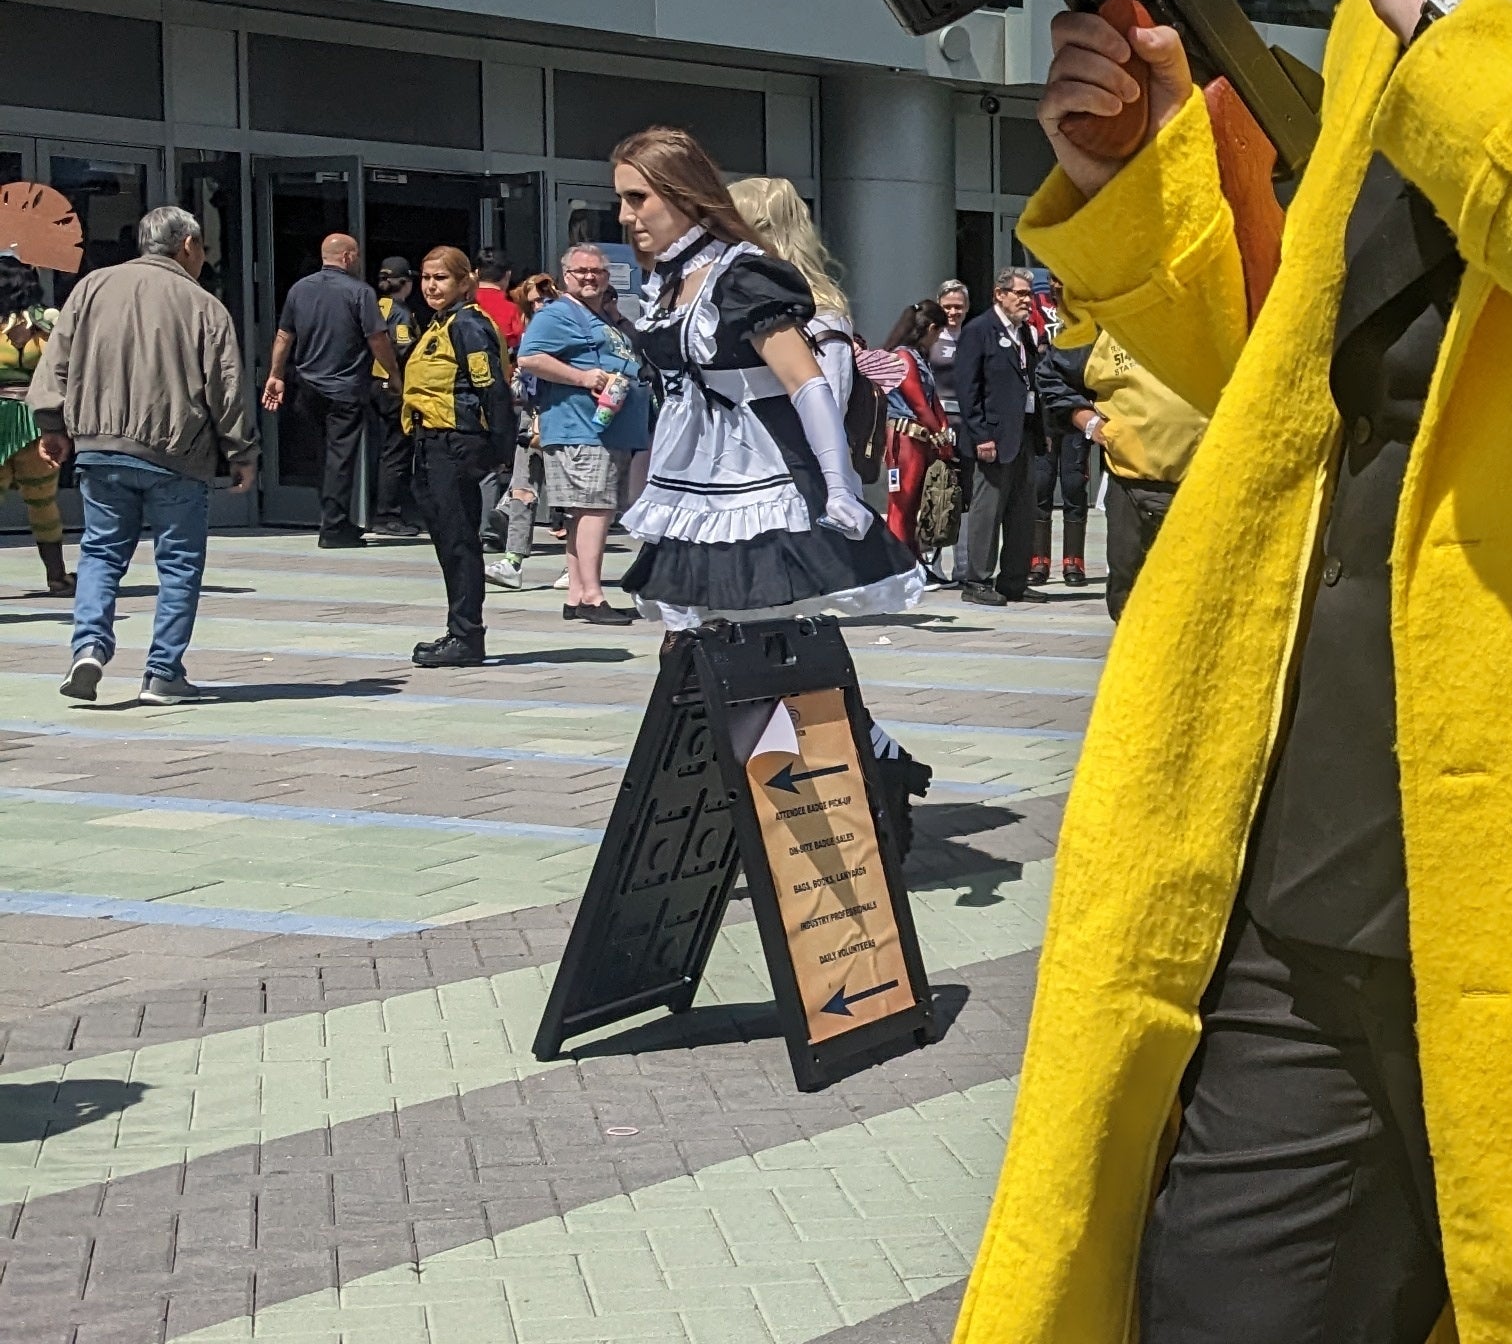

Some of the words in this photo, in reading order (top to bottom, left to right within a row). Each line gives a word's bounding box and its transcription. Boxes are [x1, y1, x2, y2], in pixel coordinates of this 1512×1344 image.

[776, 806, 805, 821] ATTENDEE
[807, 802, 828, 813] BADGE
[829, 796, 851, 808] PICK-UP
[789, 842, 813, 855] ON-SITE
[814, 837, 836, 848] BADGE
[836, 833, 854, 843] SALES
[836, 867, 867, 882] LANYARDS
[800, 915, 830, 931] INDUSTRY
[830, 900, 878, 921] PROFESSIONALS
[819, 952, 838, 965] DAILY
[837, 939, 876, 958] VOLUNTEERS
